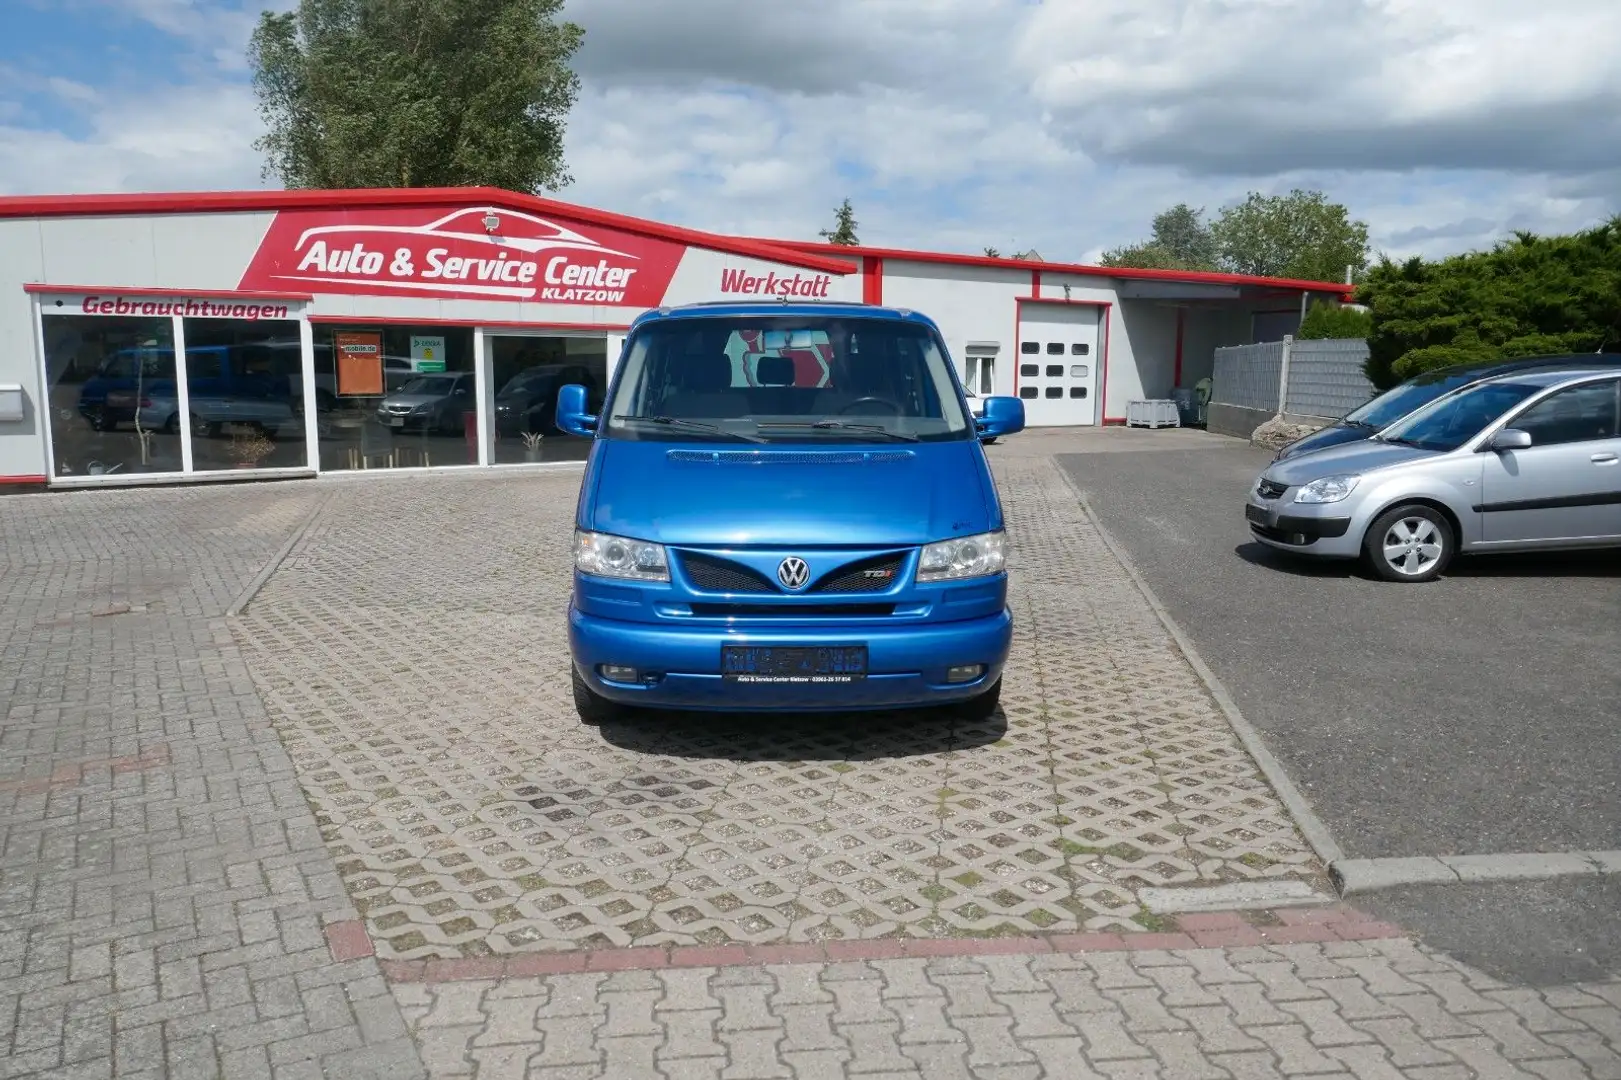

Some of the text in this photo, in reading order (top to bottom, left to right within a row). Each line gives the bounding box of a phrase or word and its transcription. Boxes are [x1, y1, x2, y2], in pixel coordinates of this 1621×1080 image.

[297, 240, 637, 288] Auto & Service Center
[541, 287, 625, 303] KLATZOW
[720, 268, 831, 298] Werkstatt
[82, 296, 288, 322] Gebrauchtwagen
